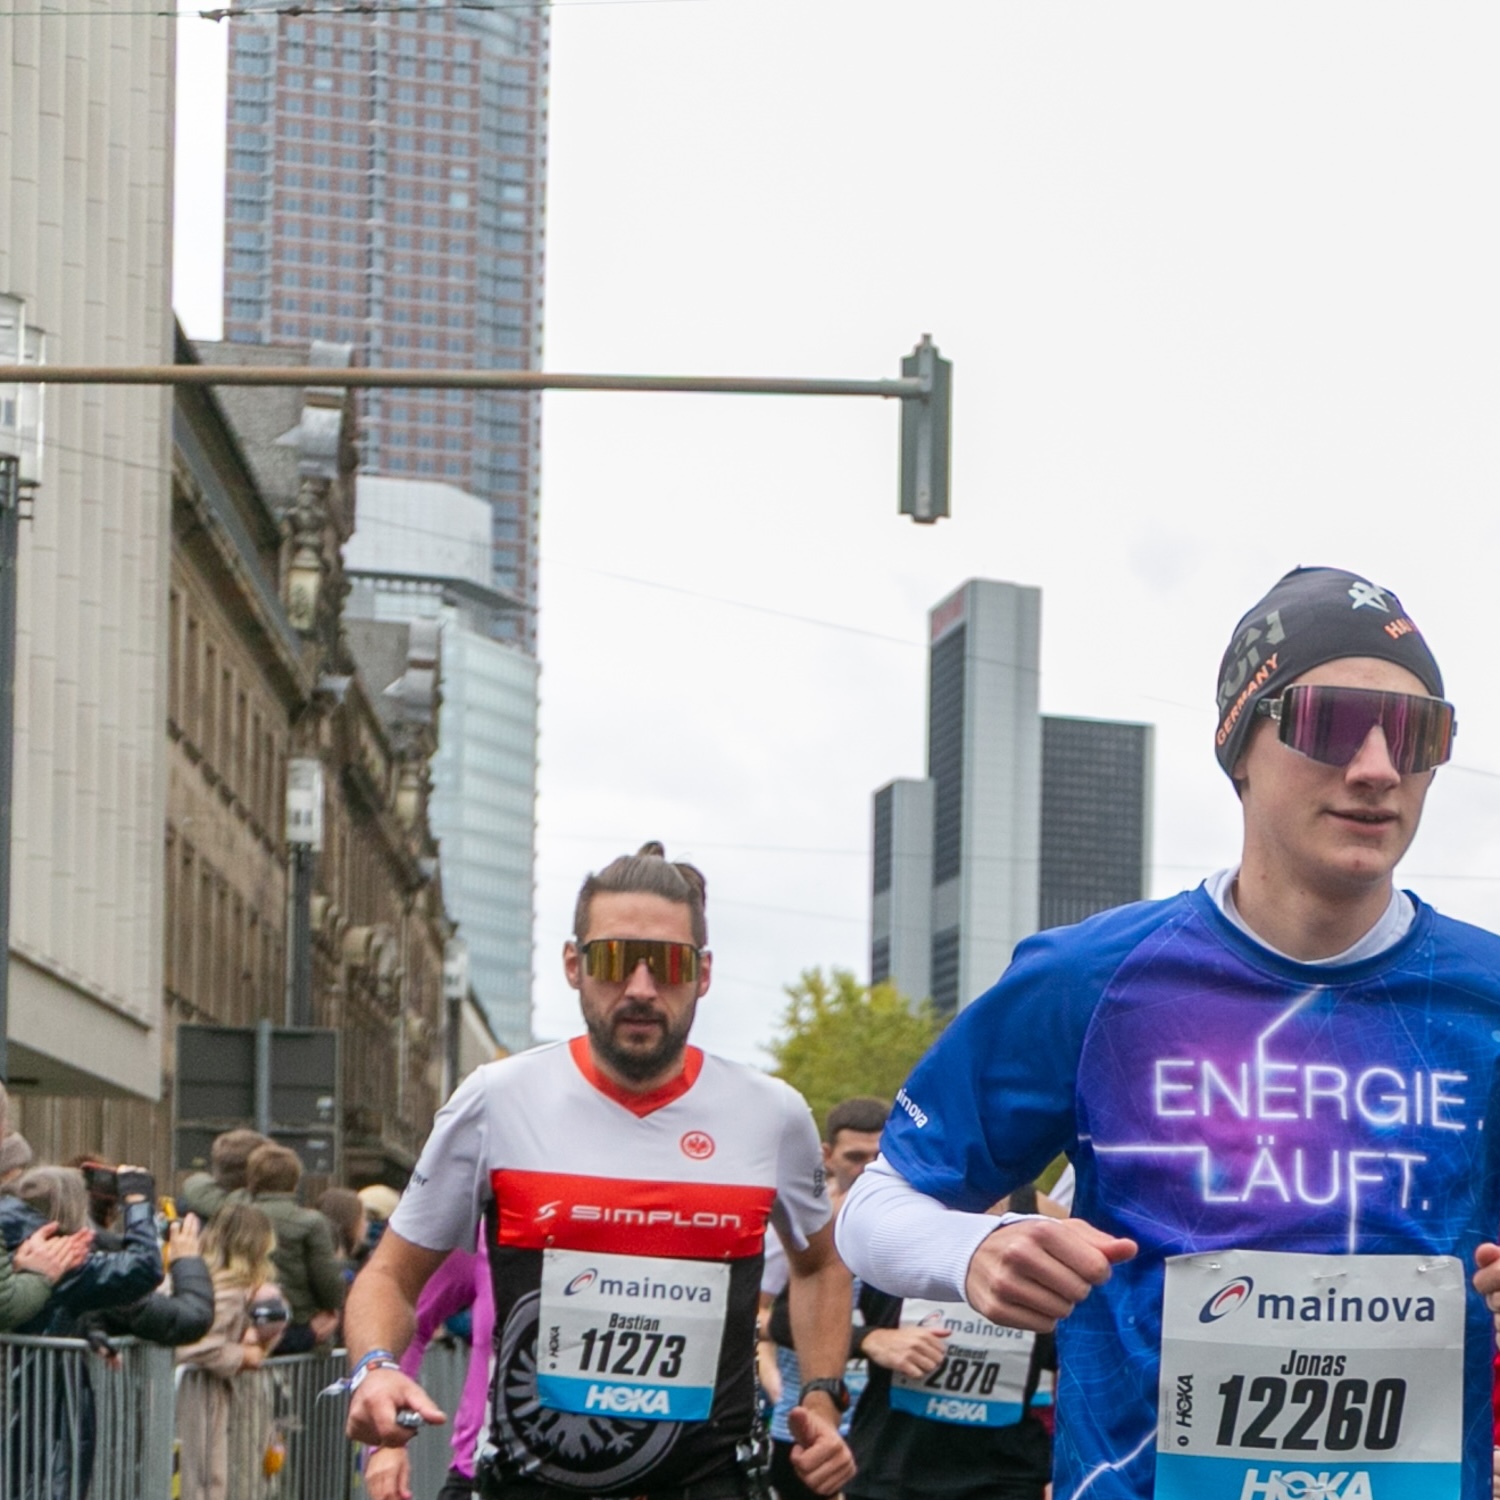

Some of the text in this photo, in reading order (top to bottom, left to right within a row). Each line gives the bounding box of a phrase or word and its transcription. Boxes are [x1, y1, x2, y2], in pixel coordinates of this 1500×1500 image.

[1216, 652, 1279, 746] GERMANY
[1155, 1059, 1484, 1131] ENERGIE.
[570, 1204, 741, 1229] SIMPLON
[600, 1277, 712, 1303] mainova
[1257, 1287, 1436, 1322] mainova
[608, 1313, 661, 1332] Bastian
[944, 1318, 1024, 1339] mainova
[549, 1326, 561, 1358] HOKA
[578, 1328, 687, 1379] 11273
[1281, 1350, 1347, 1377] Jonas
[585, 1384, 671, 1415] HOKA
[926, 1397, 988, 1422] HOKA
[1176, 1373, 1194, 1428] HOKA
[1216, 1374, 1407, 1451] 12260
